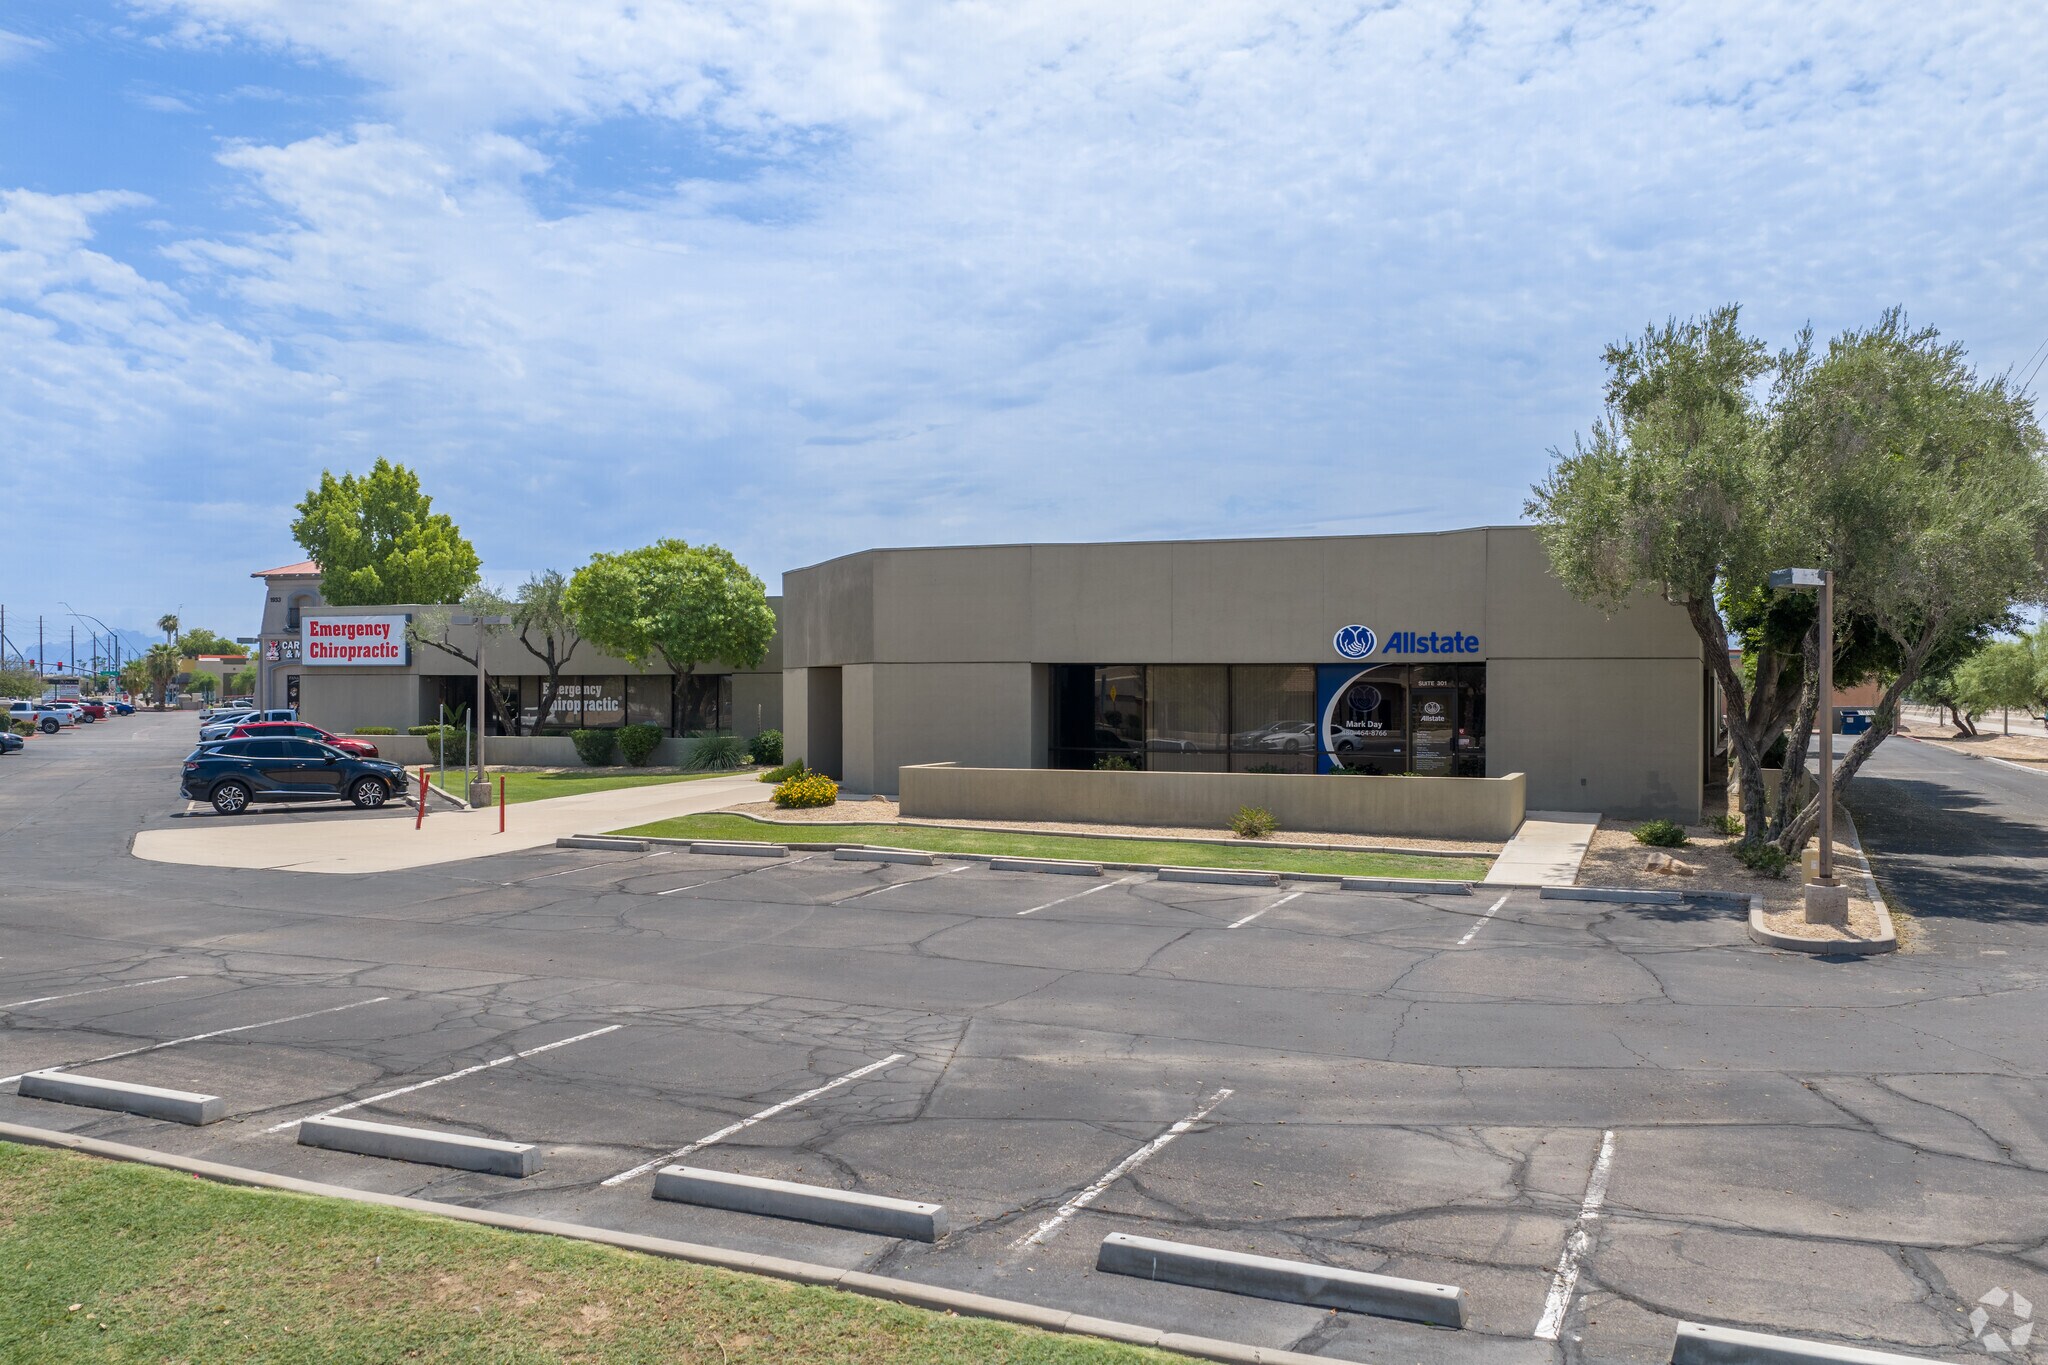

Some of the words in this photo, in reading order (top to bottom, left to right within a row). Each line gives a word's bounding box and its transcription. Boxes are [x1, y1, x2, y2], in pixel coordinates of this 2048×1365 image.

[310, 621, 390, 640] Emergency
[1382, 631, 1479, 653] Allstate
[286, 650, 293, 658] &
[310, 642, 399, 661] Chiropractic
[543, 682, 602, 697] Eergency
[1346, 720, 1366, 728] Mark
[1368, 720, 1383, 730] Day
